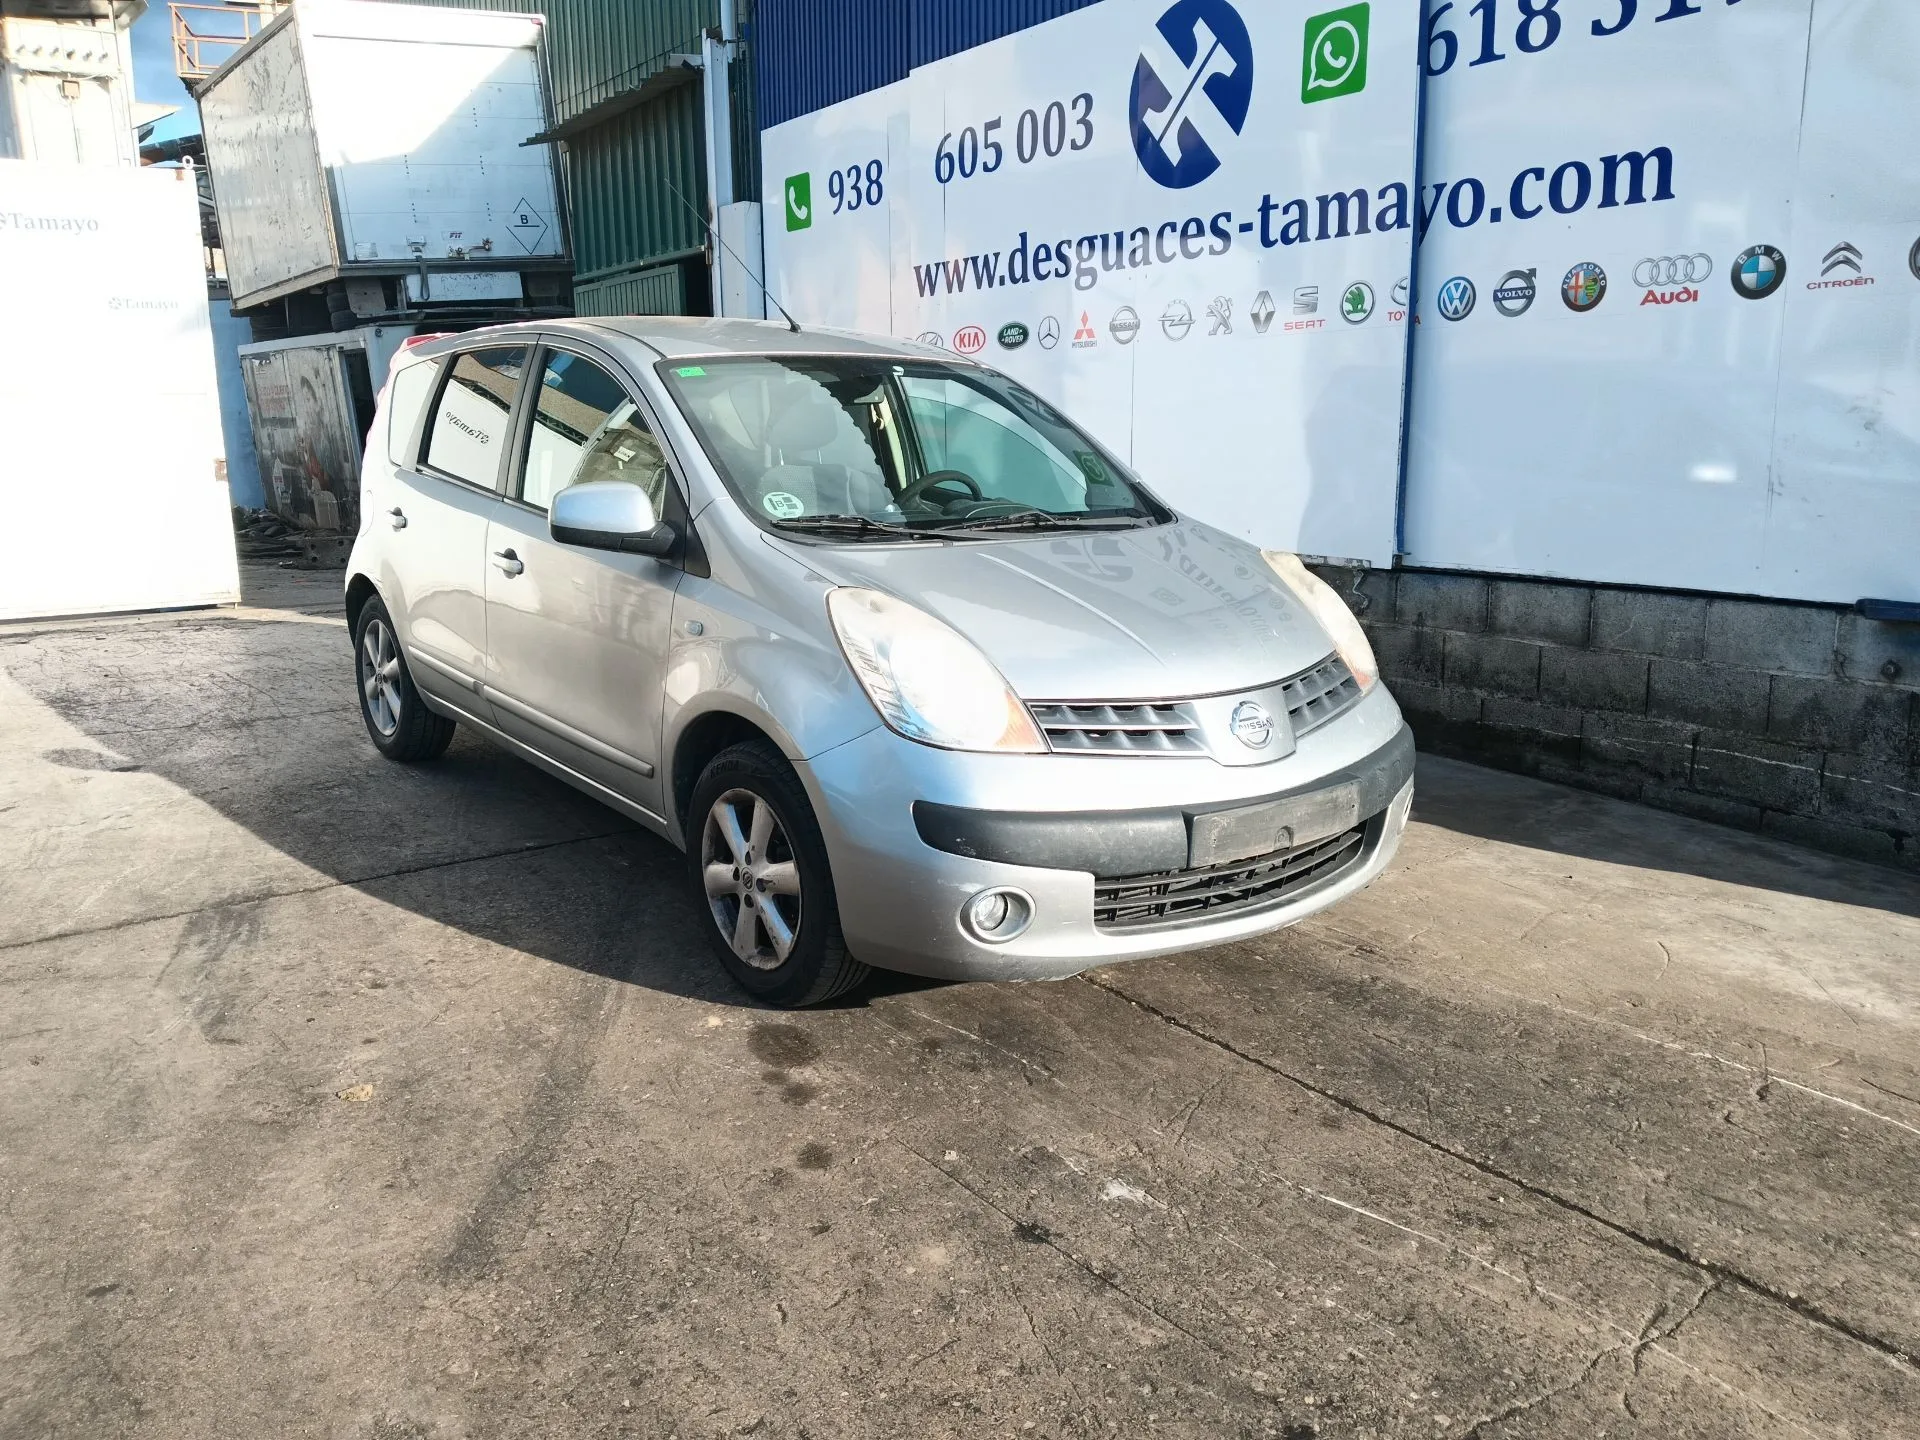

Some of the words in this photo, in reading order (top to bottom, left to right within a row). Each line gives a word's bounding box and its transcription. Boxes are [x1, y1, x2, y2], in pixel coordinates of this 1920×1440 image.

[1427, 0, 1562, 77] 618
[828, 159, 884, 215] 938
[935, 115, 1003, 184] 605
[1016, 92, 1094, 164] 003
[7, 212, 100, 236] Tamayo
[520, 214, 529, 225] B
[1562, 267, 1577, 290] ALFA
[1496, 289, 1533, 299] VOLVO
[1110, 319, 1139, 330] NISSAN
[1283, 319, 1326, 331] SEAT
[1003, 327, 1019, 336] LAND
[957, 332, 980, 348] KIA
[1004, 334, 1024, 344] ROVER
[1238, 716, 1273, 730] NISSAN
